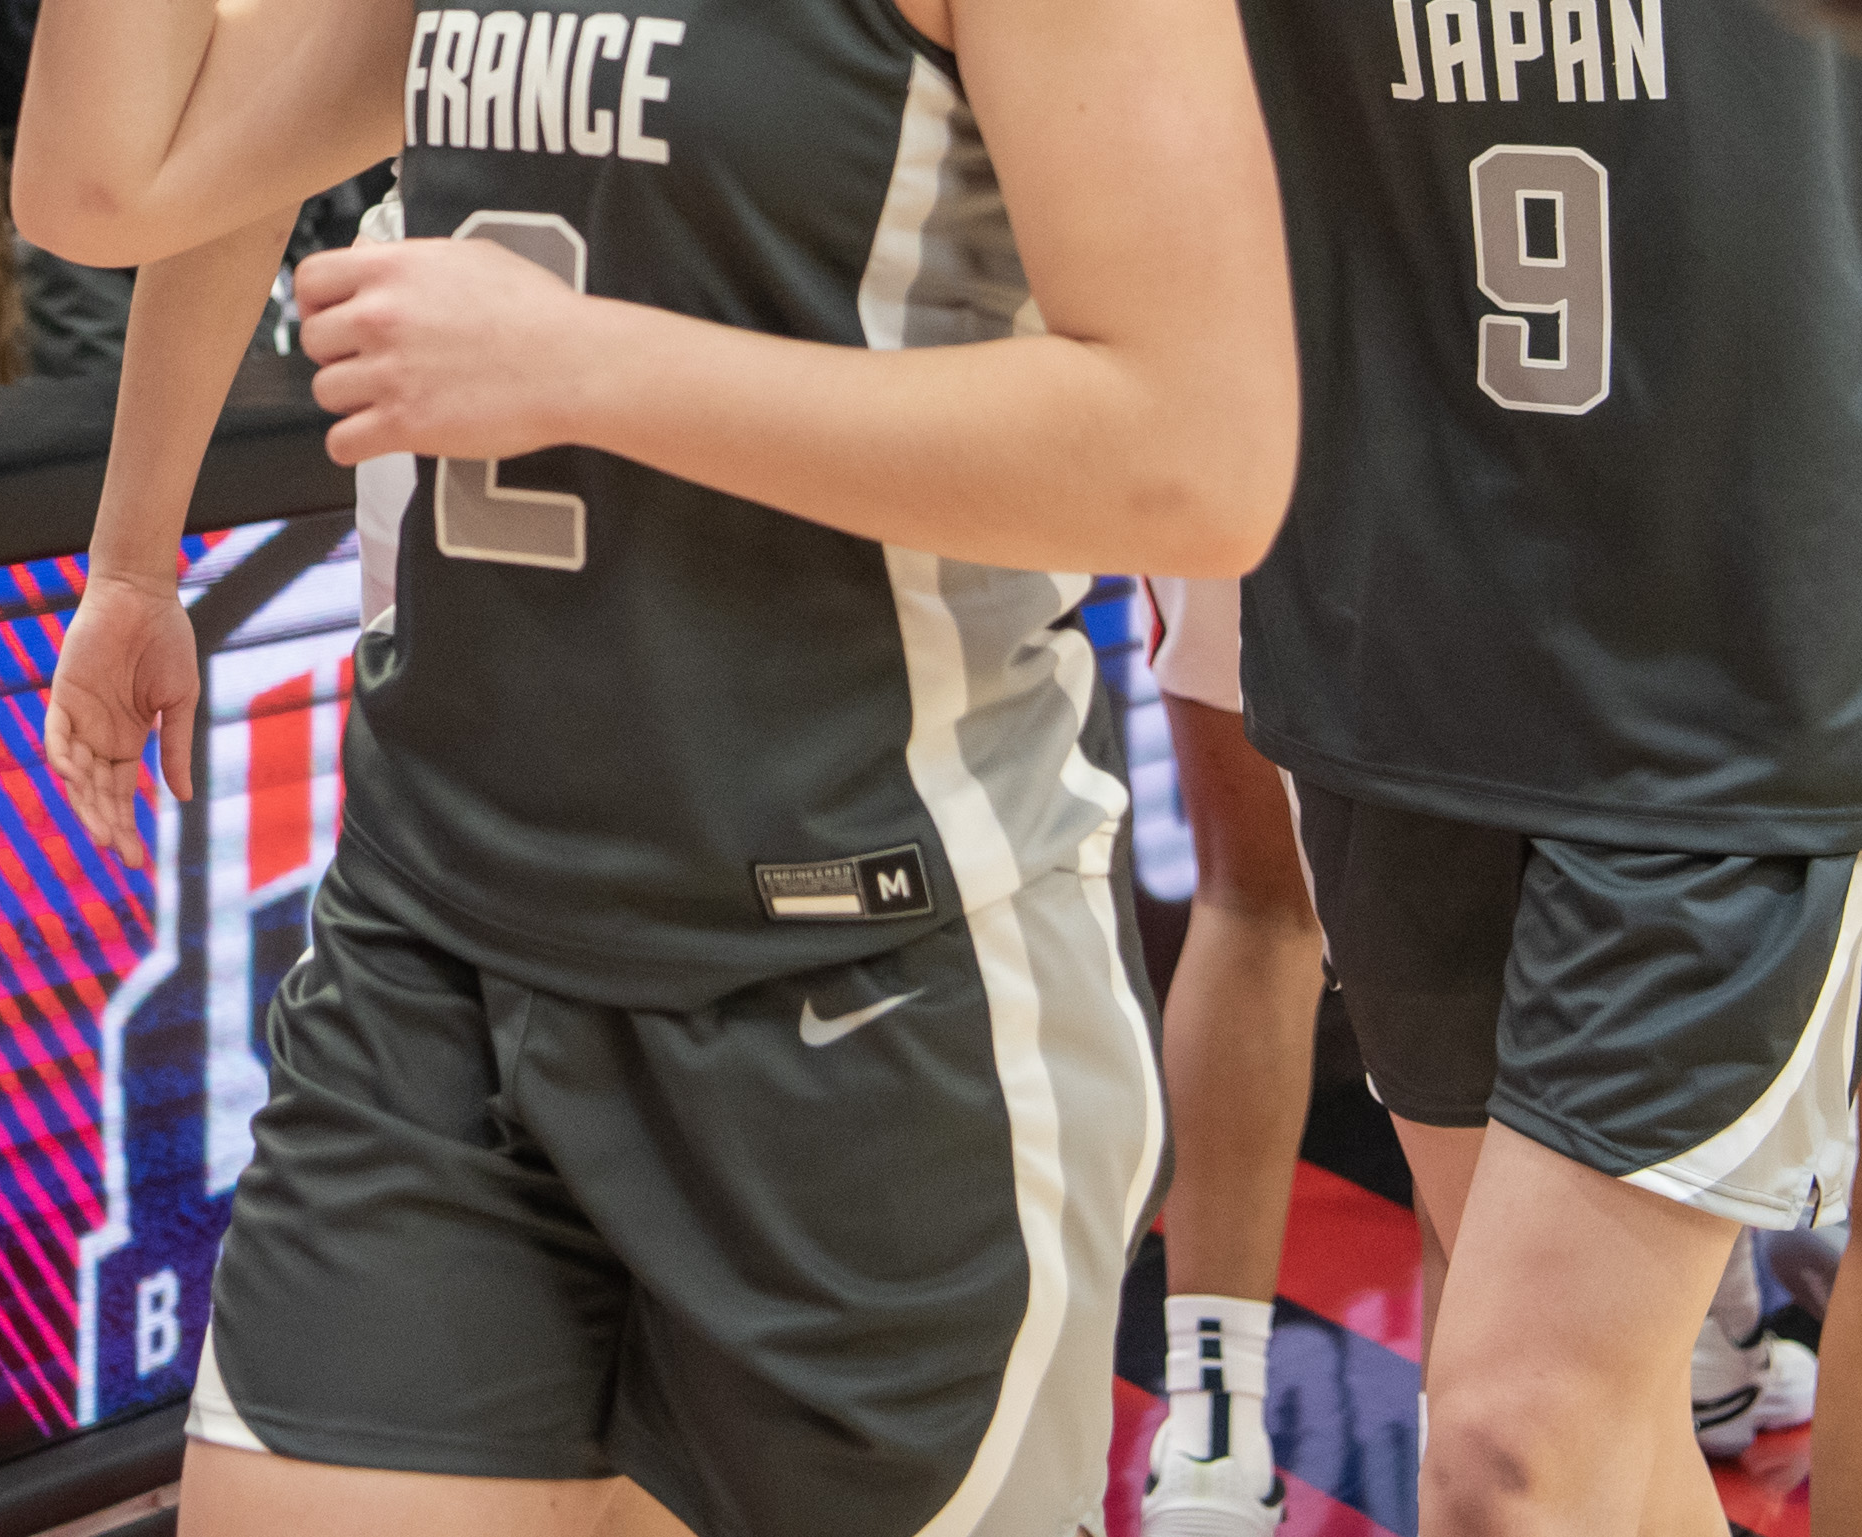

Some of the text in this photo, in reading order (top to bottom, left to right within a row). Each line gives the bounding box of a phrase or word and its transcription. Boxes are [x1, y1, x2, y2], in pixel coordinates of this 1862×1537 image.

[404, 10, 686, 165] FRANCE
[1469, 144, 1612, 415] 9
[876, 867, 912, 903] M
